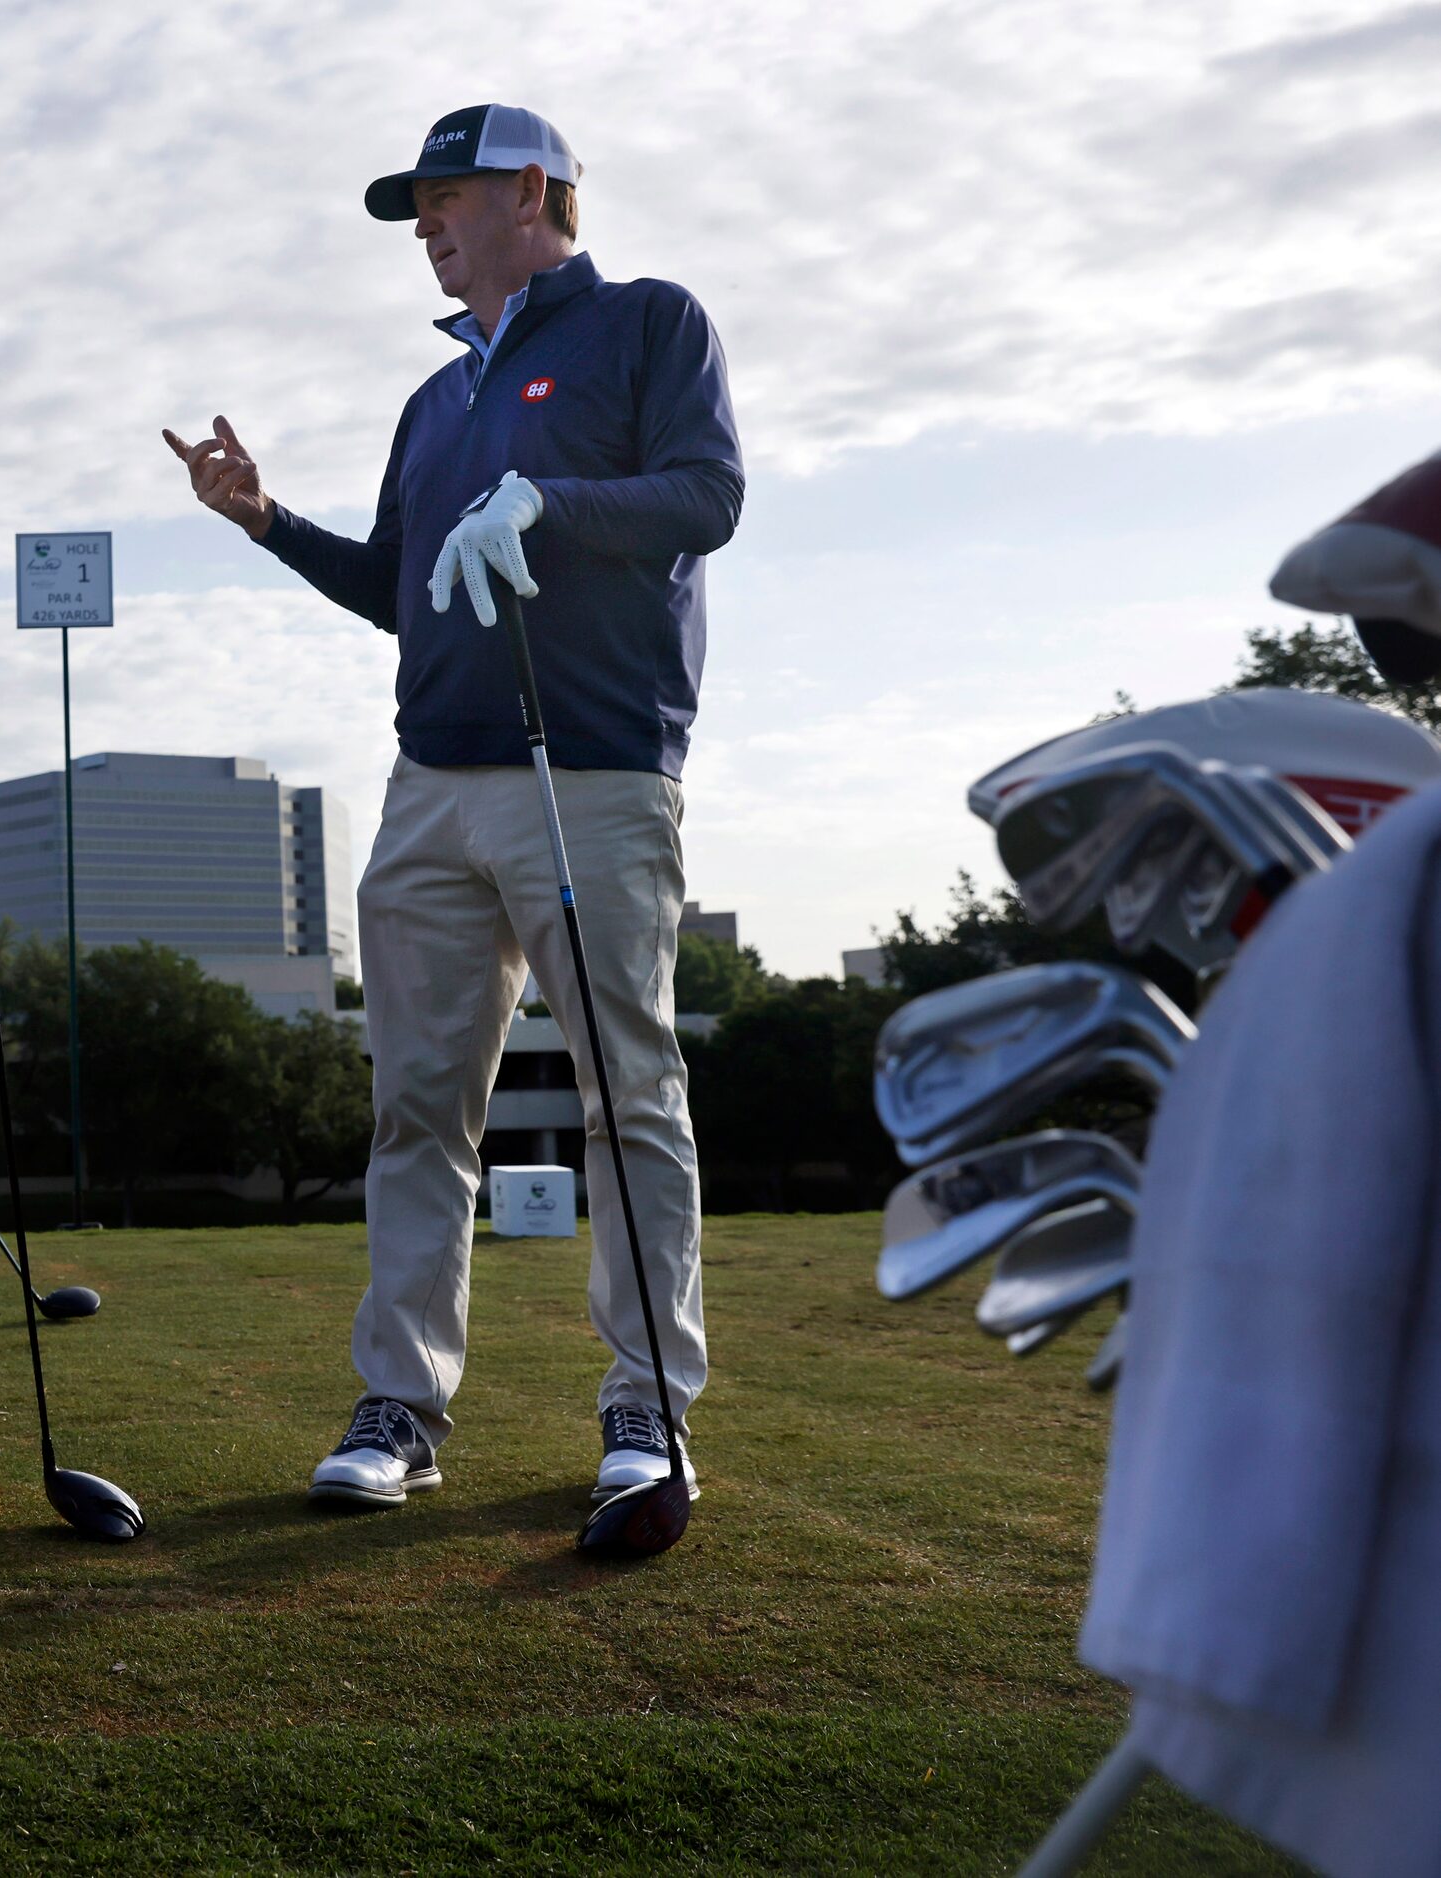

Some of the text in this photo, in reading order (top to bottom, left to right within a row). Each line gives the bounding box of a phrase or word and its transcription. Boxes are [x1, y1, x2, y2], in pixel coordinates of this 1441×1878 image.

[66, 543, 100, 555] HOLE
[78, 563, 91, 583] 1
[47, 592, 83, 604] PAR 4
[32, 609, 99, 622] 426 YARDS
